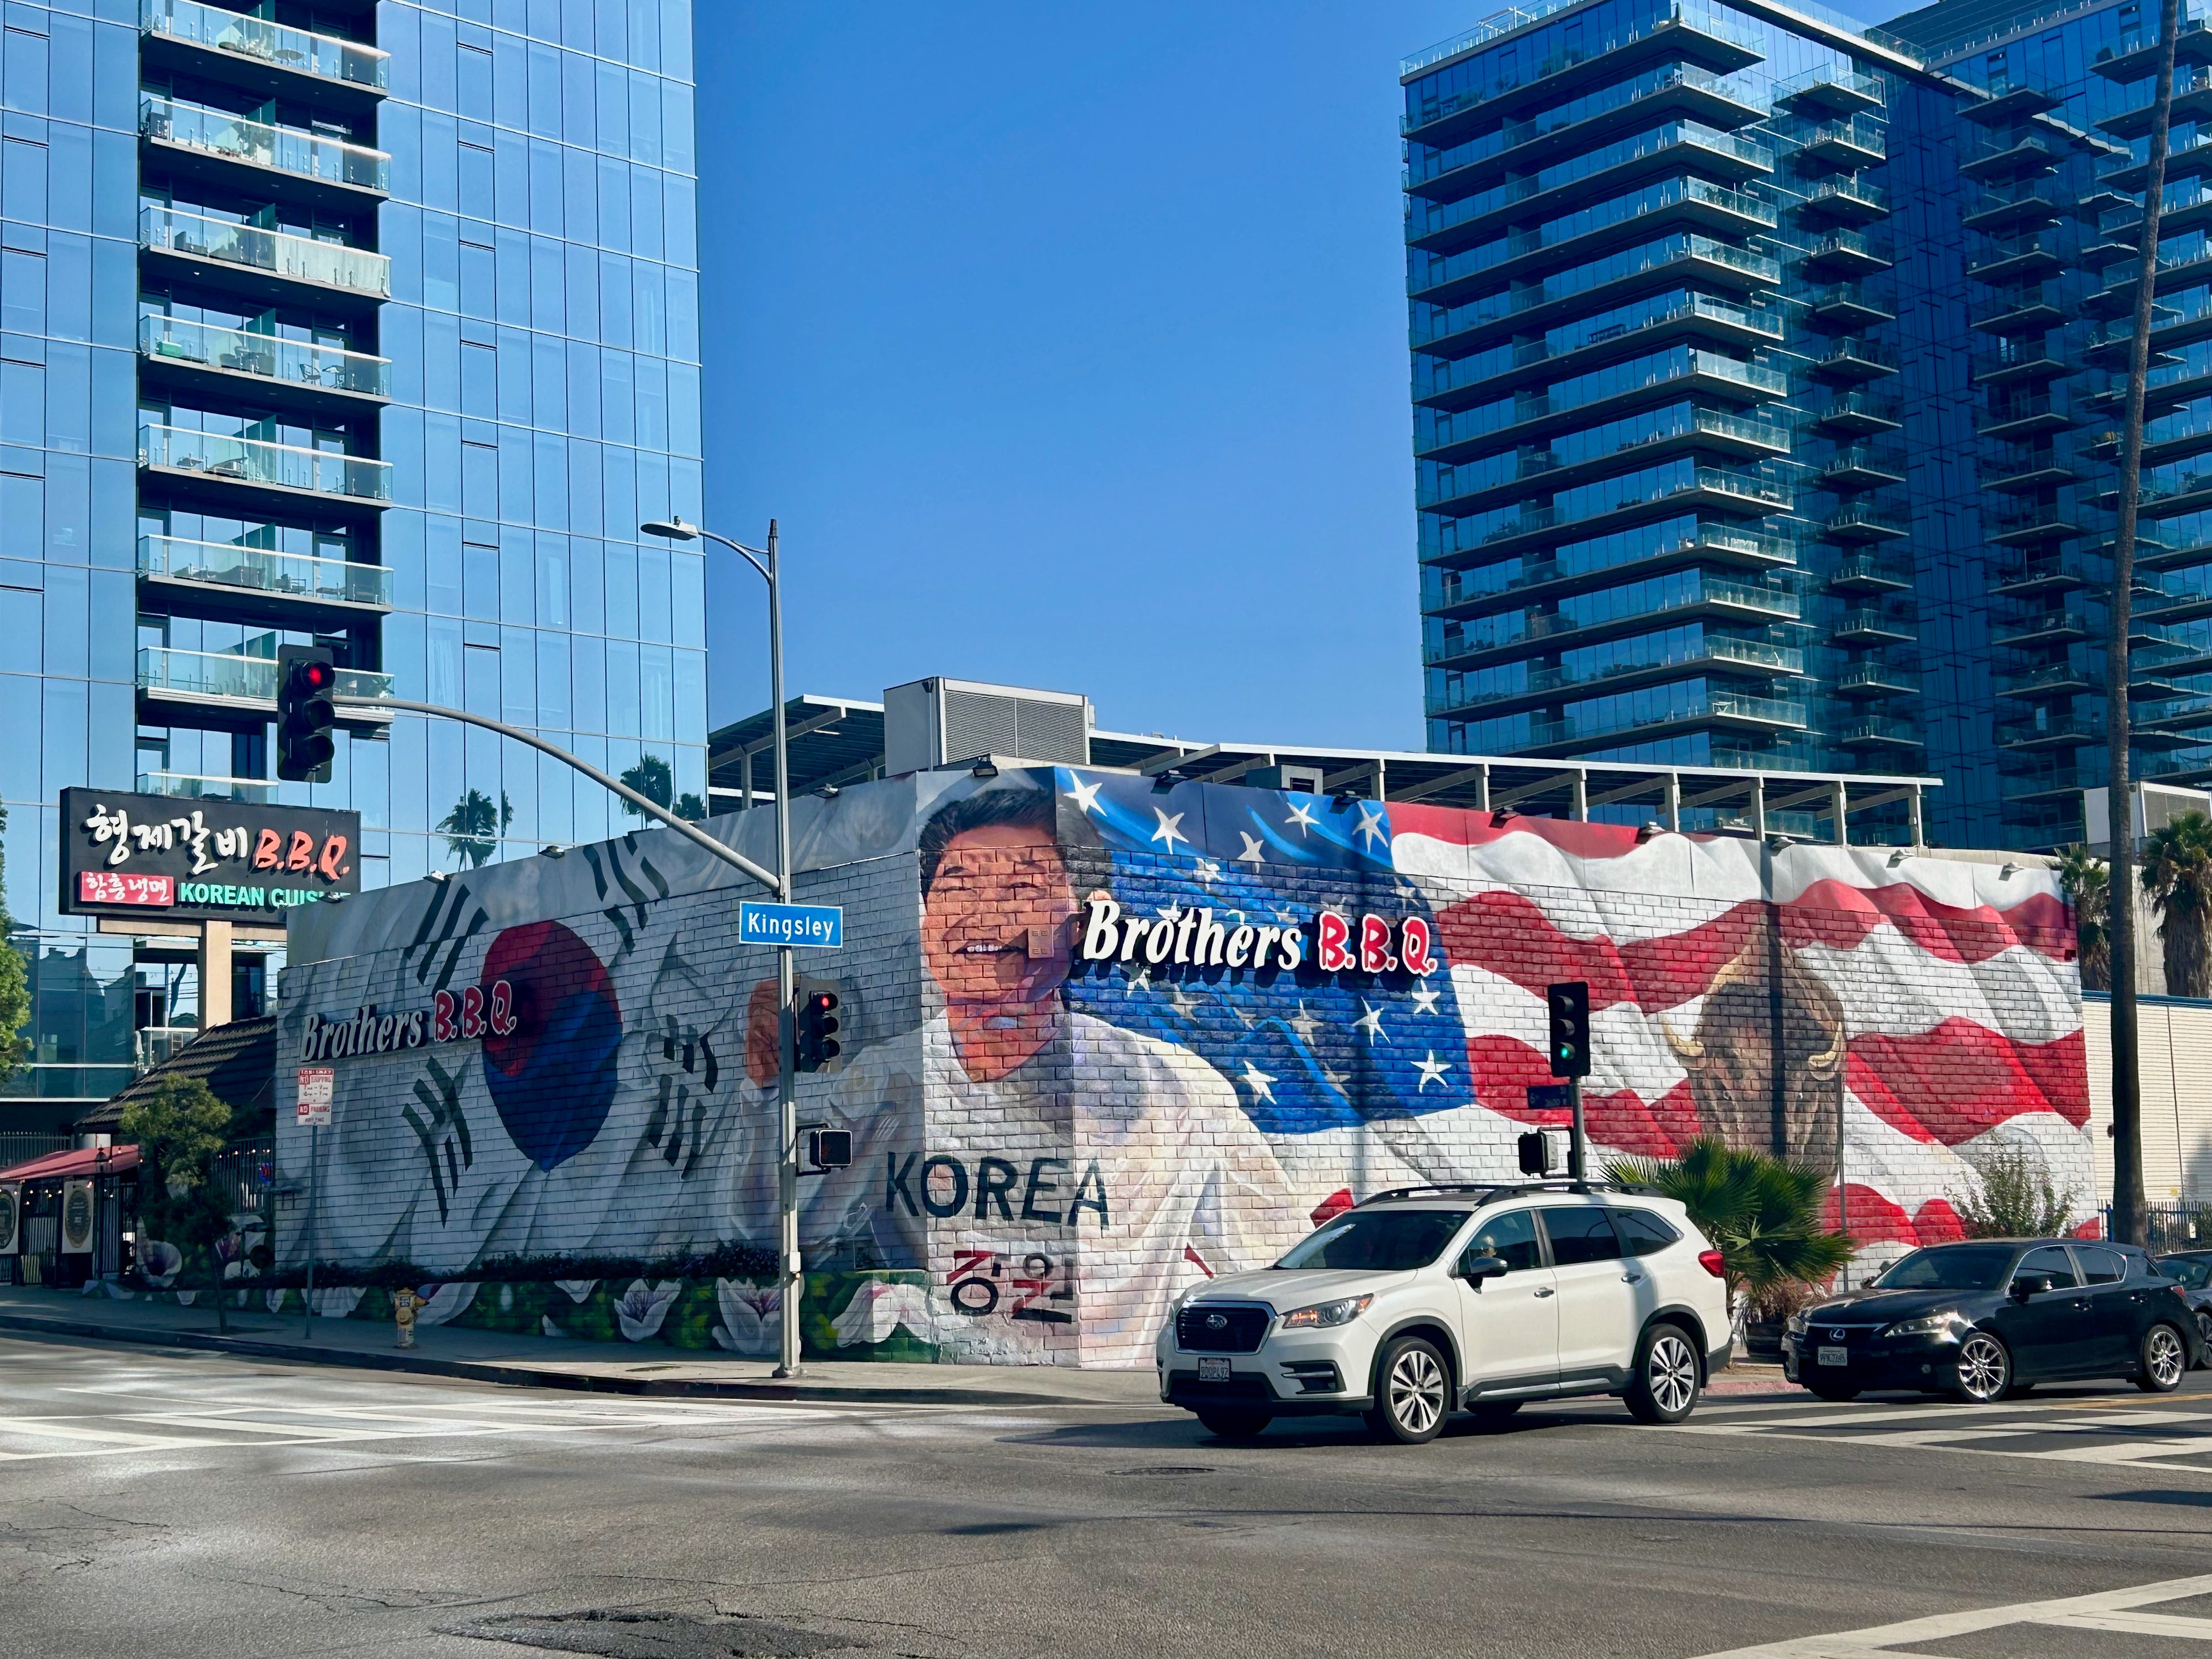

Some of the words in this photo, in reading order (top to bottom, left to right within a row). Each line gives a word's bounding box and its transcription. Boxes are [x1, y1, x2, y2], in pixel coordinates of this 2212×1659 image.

[86, 804, 248, 875] 형제갈비
[253, 828, 350, 880] B.B.Q.
[178, 882, 265, 907] KOREAN
[270, 887, 351, 909] CUIS
[748, 912, 834, 942] Kingsley
[1083, 900, 1303, 970] Brothers
[1317, 910, 1438, 977] B.B.Q.
[300, 1004, 426, 1062] Brothers
[434, 980, 518, 1043] B.B.Q.
[886, 1151, 1110, 1230] KOREA
